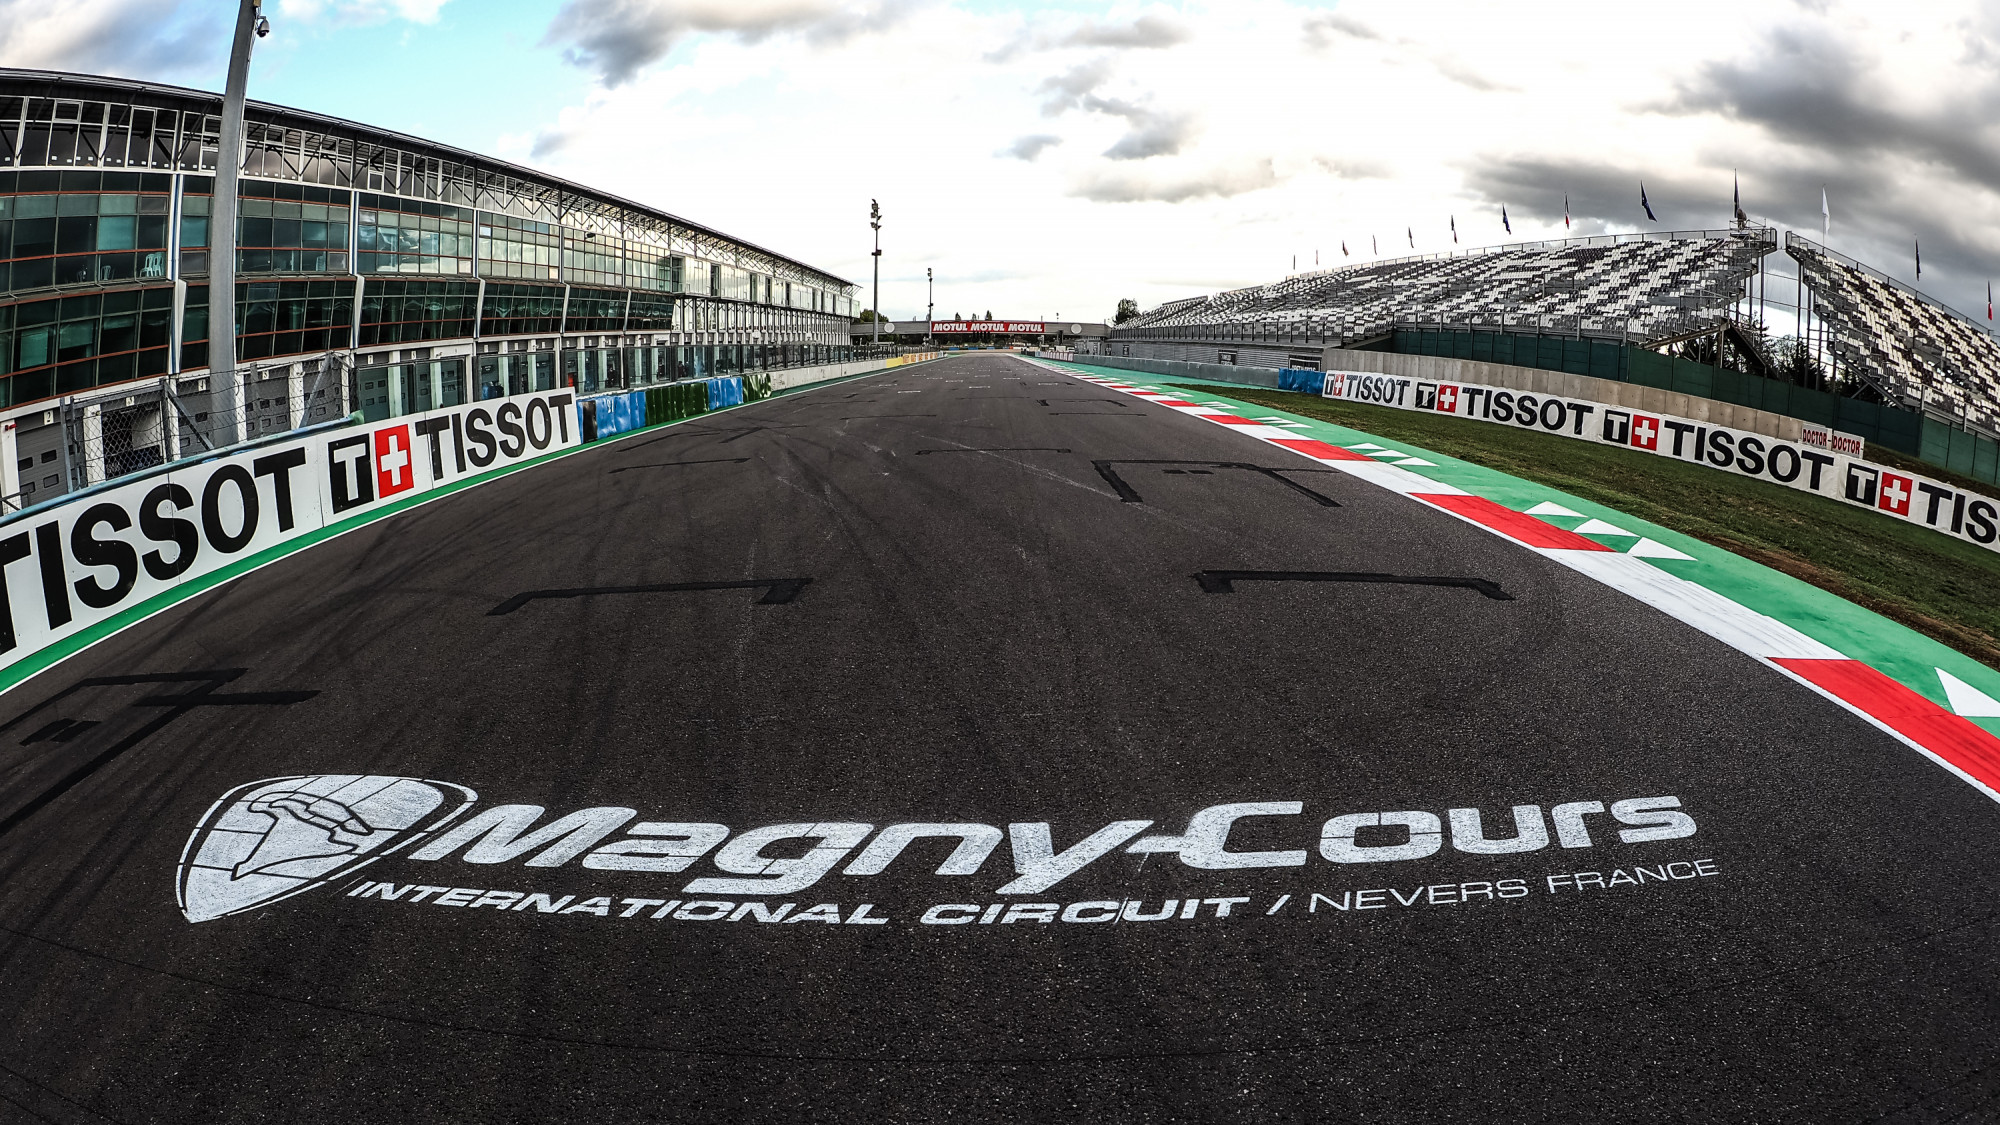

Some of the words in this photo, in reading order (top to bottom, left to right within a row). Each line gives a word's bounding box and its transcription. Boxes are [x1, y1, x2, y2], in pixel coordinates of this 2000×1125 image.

[933, 323, 968, 332] MOTUL
[970, 323, 1005, 332] MOTUL
[1007, 323, 1043, 333] MOTUL
[1346, 375, 1411, 406] TISSOT
[1462, 387, 1595, 436] TISSOT
[1664, 420, 1834, 491] TISSOT
[1917, 481, 2000, 544] TIS
[0, 447, 306, 656] TISSOT
[416, 394, 573, 480] TISSOT
[348, 881, 890, 925] INTERNATIONAL
[919, 897, 1250, 926] CIRCUIT
[1308, 877, 1529, 914] NEVERS
[1546, 858, 1720, 895] FRANCE
[408, 795, 1698, 896] Magny-Cours
